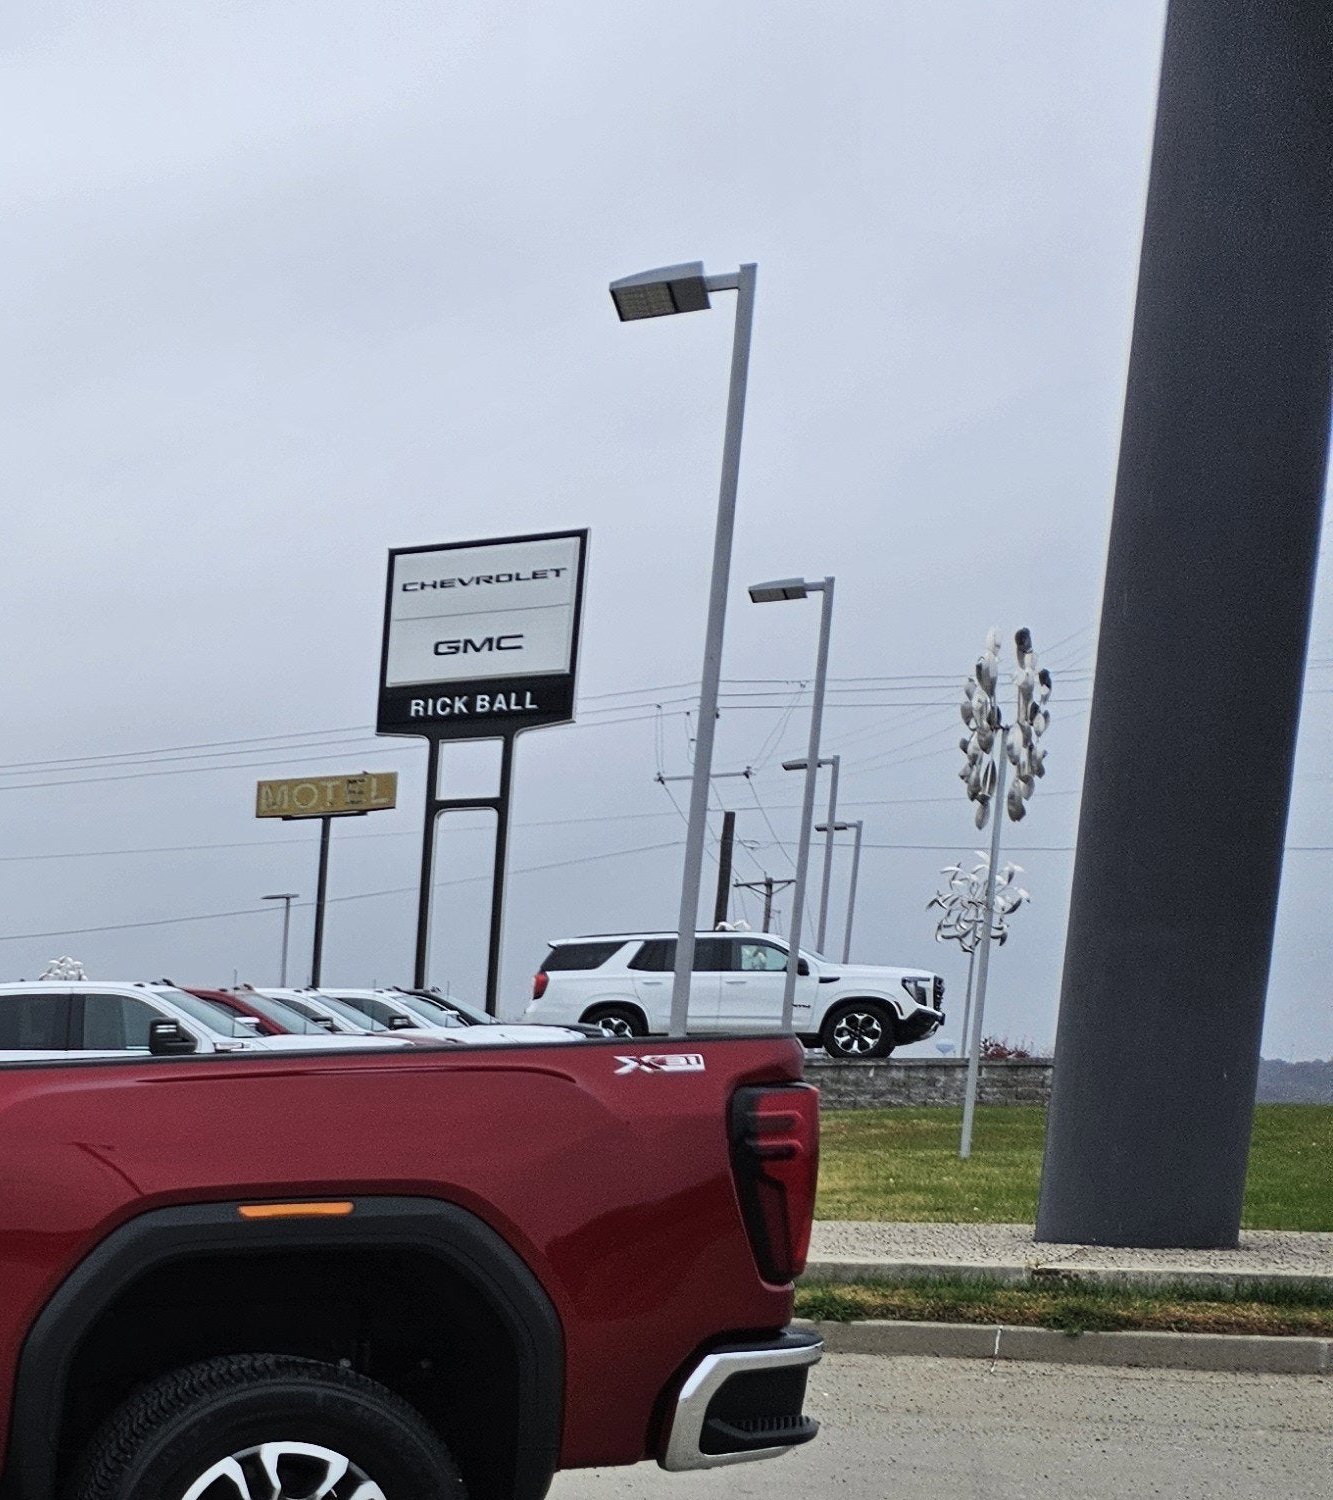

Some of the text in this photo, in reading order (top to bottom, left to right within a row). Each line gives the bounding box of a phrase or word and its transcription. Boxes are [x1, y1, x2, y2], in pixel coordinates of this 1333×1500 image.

[402, 567, 567, 592] CHEVROLET
[434, 634, 524, 656] GMC
[410, 691, 539, 718] RICK BALL
[261, 777, 391, 809] MOTEL
